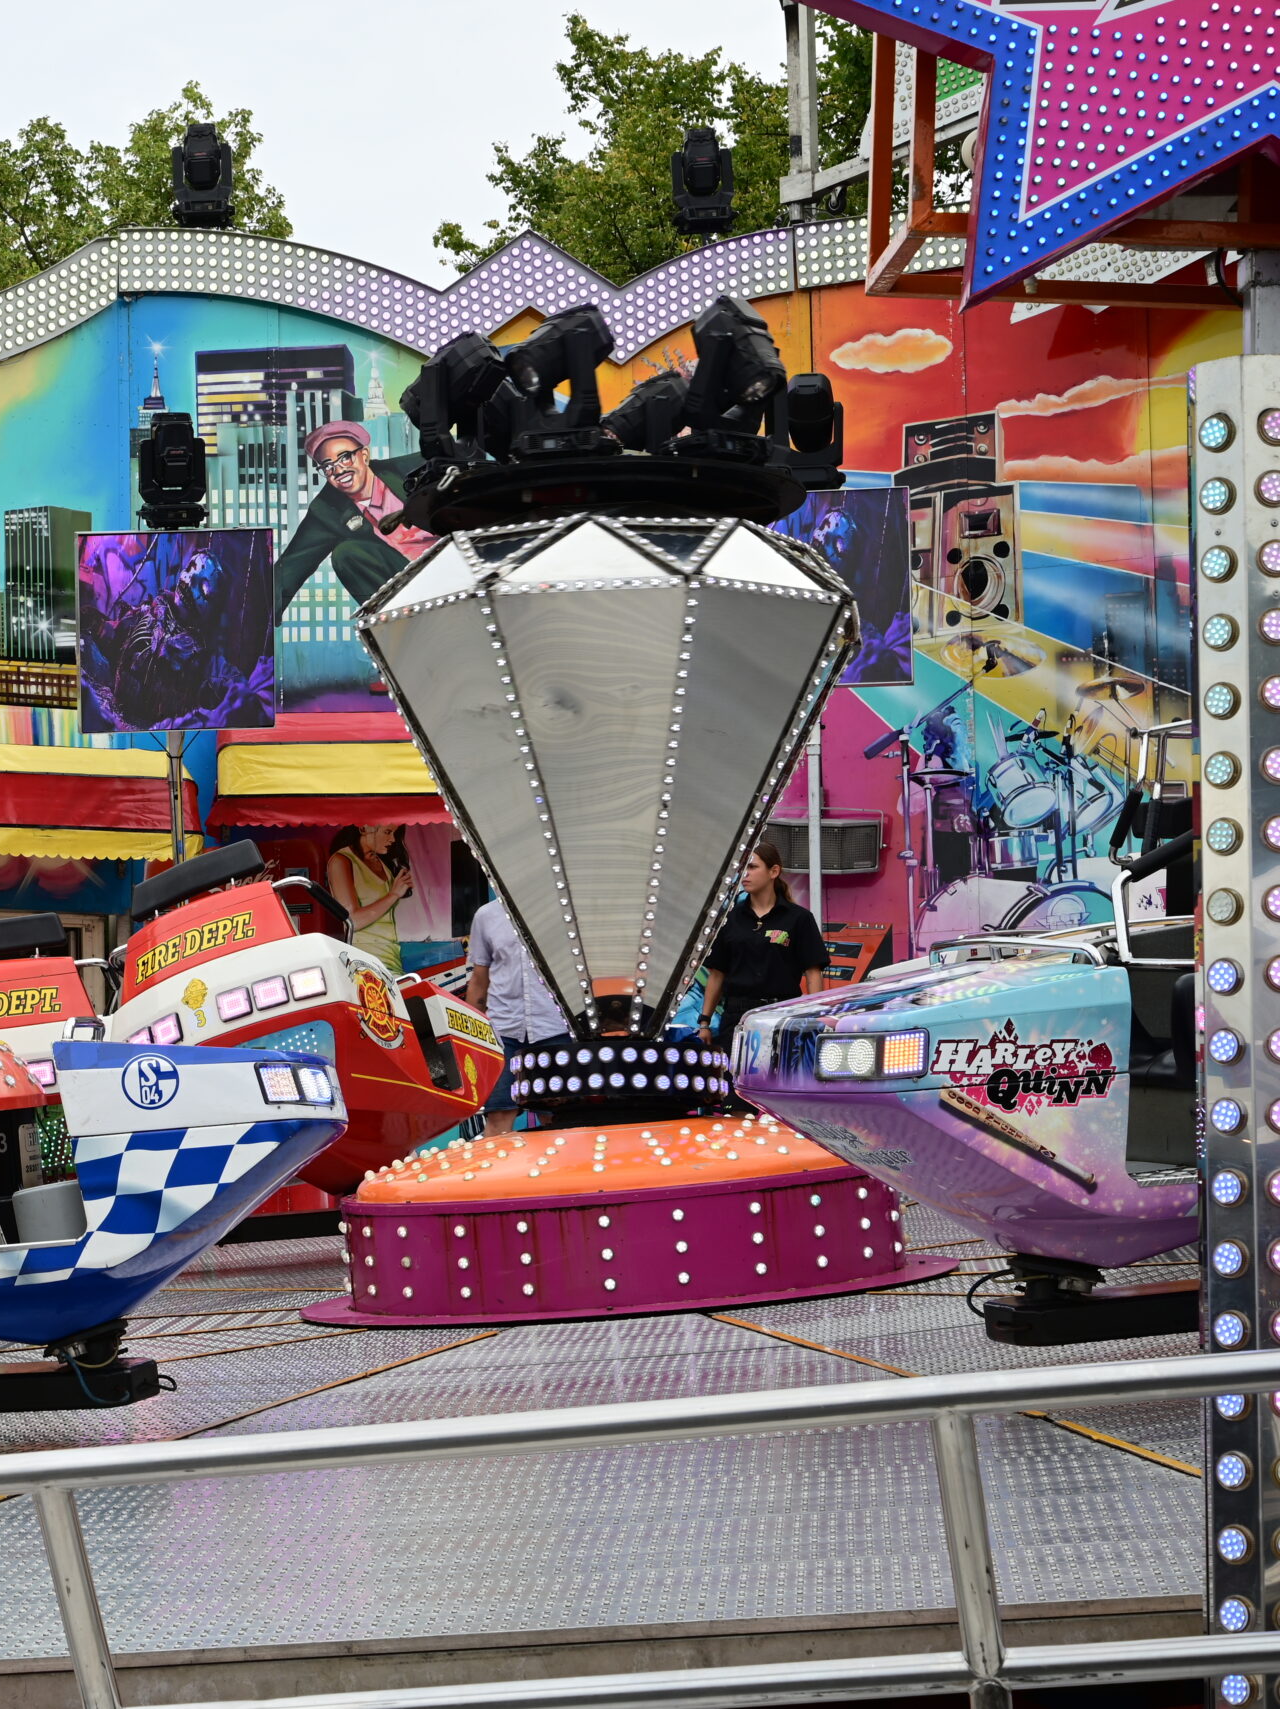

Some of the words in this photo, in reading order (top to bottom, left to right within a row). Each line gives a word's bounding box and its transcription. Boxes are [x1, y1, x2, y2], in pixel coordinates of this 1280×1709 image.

[136, 936, 181, 985] FIRE
[182, 912, 255, 959] DEPT.
[194, 1010, 207, 1028] 3
[744, 1028, 761, 1076] 12
[142, 1086, 160, 1104] 04
[947, 1090, 981, 1116] GOOD
[984, 1114, 1024, 1140] NIGHT
